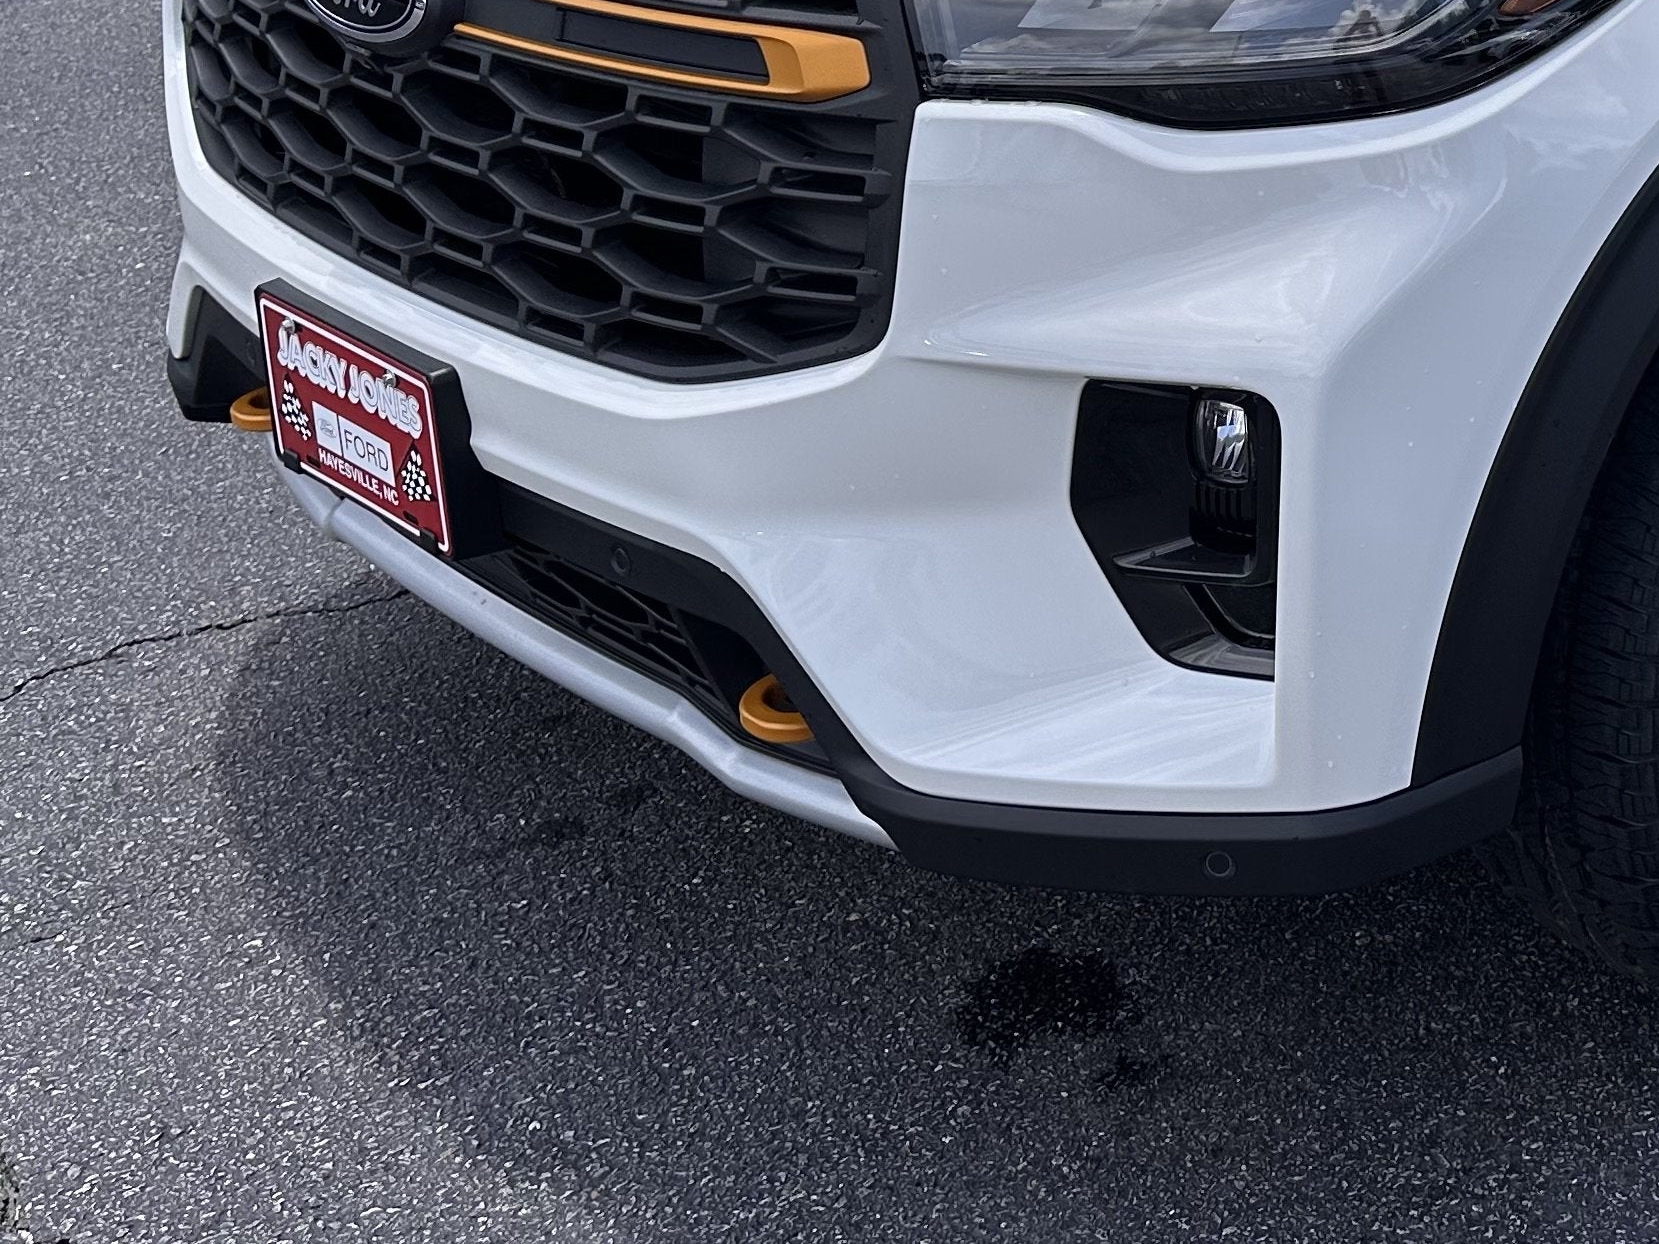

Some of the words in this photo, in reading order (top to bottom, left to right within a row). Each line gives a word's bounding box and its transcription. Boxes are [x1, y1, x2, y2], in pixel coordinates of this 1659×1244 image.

[277, 326, 347, 398] JACKY
[348, 364, 422, 439] JONES
[318, 447, 382, 499] HAYESVILLE,
[382, 484, 399, 506] NC
[343, 429, 388, 471] FORD
